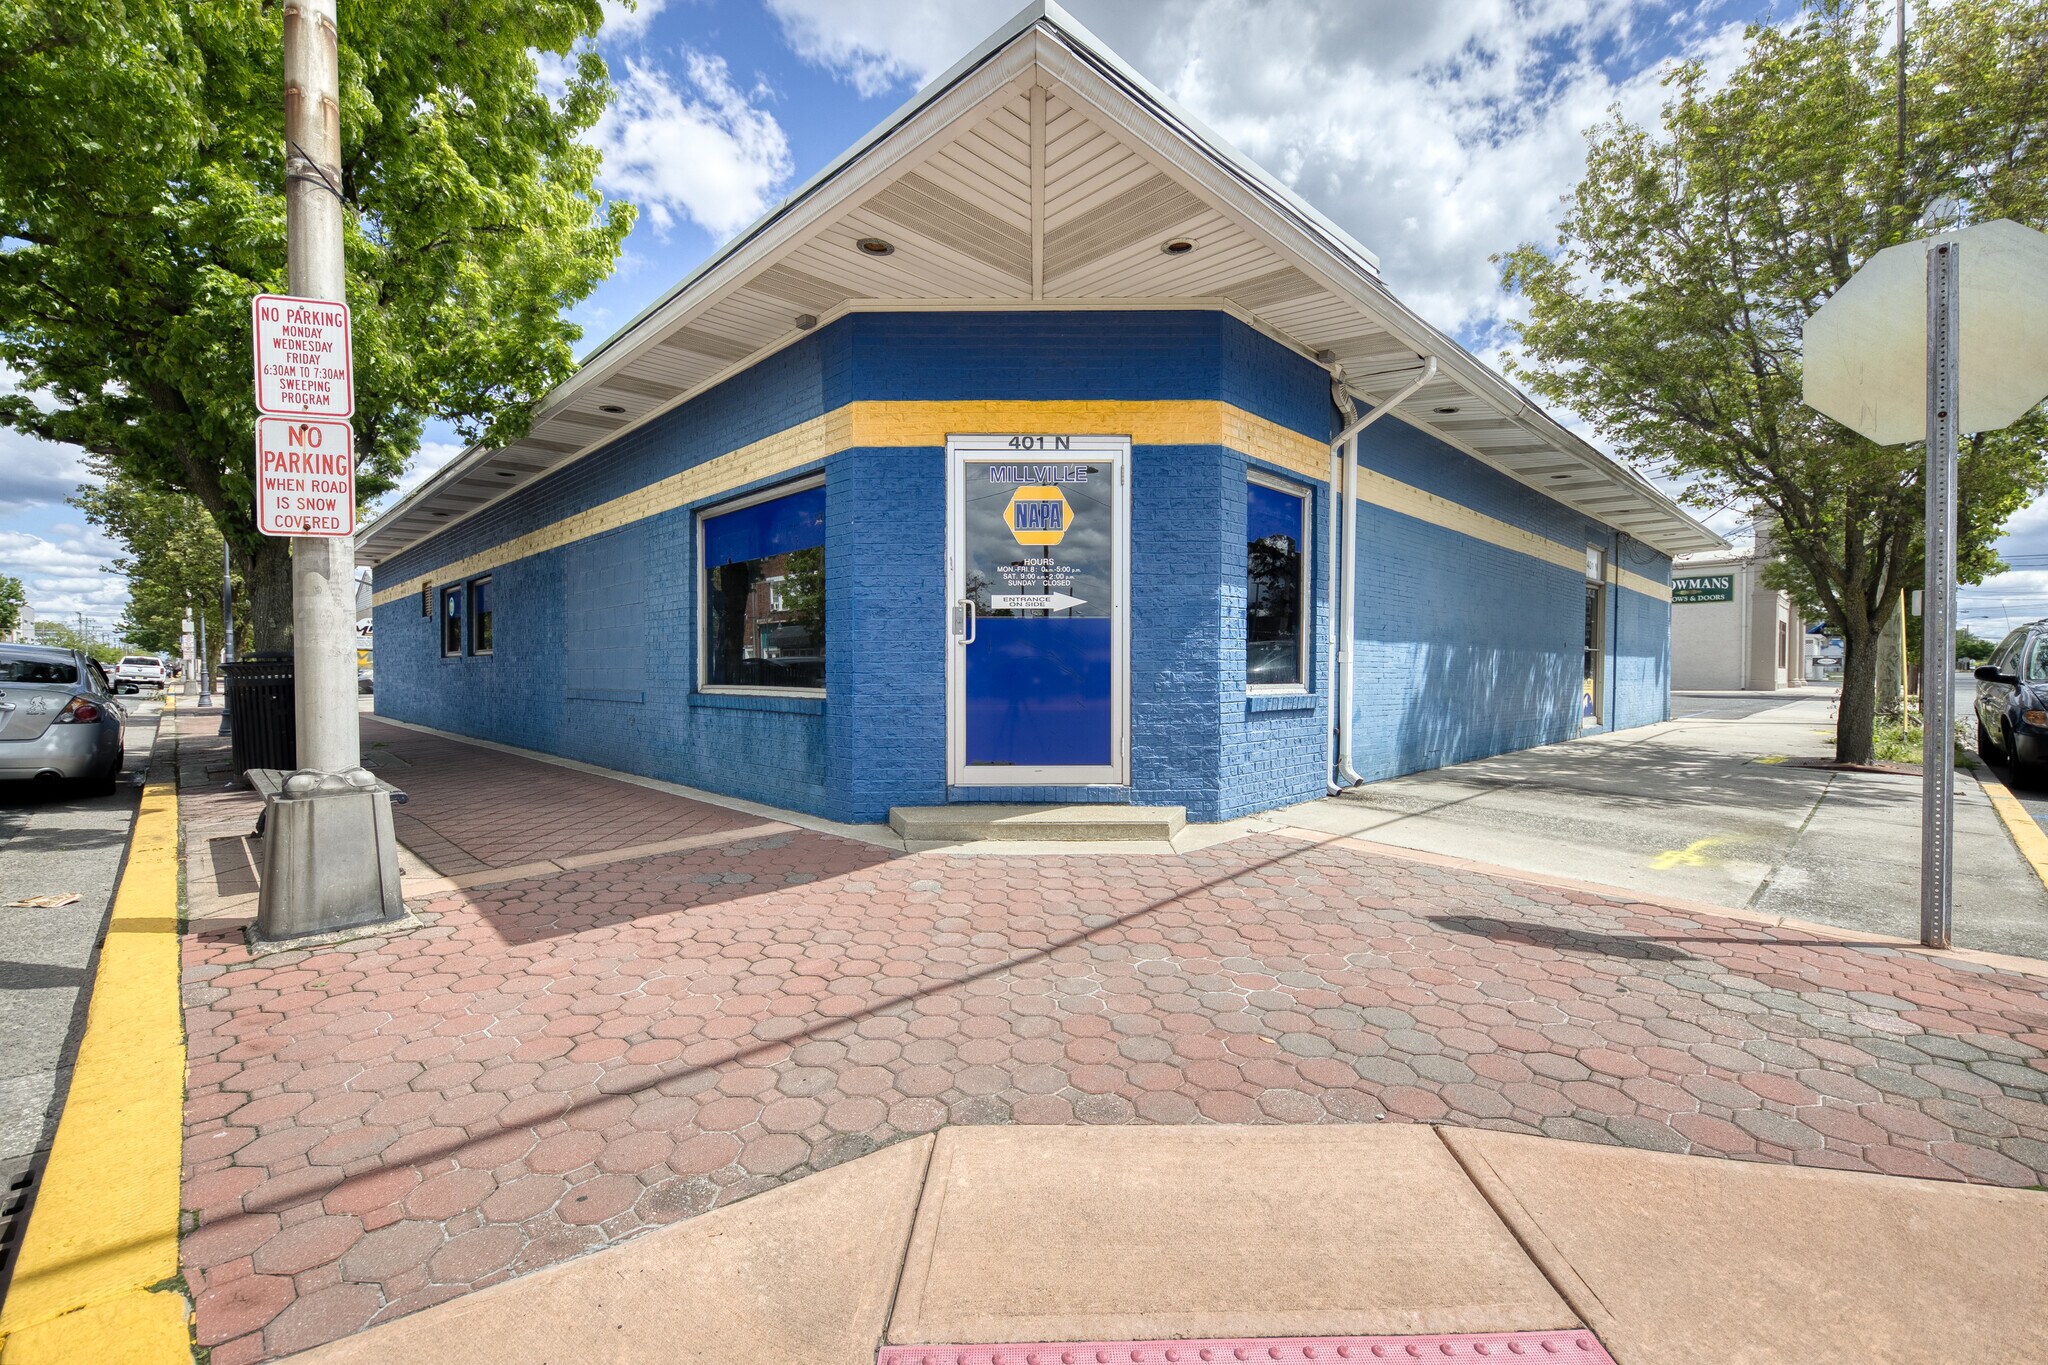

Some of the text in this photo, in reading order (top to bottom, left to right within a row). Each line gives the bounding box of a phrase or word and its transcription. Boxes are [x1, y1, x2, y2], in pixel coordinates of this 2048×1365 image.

[261, 307, 343, 328] NO PARKING
[282, 325, 322, 339] MONDAY
[273, 338, 333, 353] WEDNESDAY
[286, 352, 321, 365] FRIDAY
[263, 364, 345, 380] 6:30AM TO 7:30AM
[279, 378, 331, 393] SWEEPING
[281, 391, 330, 406] PROGRAM
[288, 425, 322, 449] NO
[1008, 436, 1070, 450] 401 N
[264, 450, 348, 477] PARKING
[989, 465, 1088, 483] MILLVILLE
[265, 477, 348, 494] WHEN ROAD
[276, 496, 337, 512] IS SNOW
[274, 514, 340, 530] COVERED
[1015, 502, 1062, 529] NAPA
[1024, 558, 1055, 566] HOURS
[1697, 593, 1725, 602] DOORS
